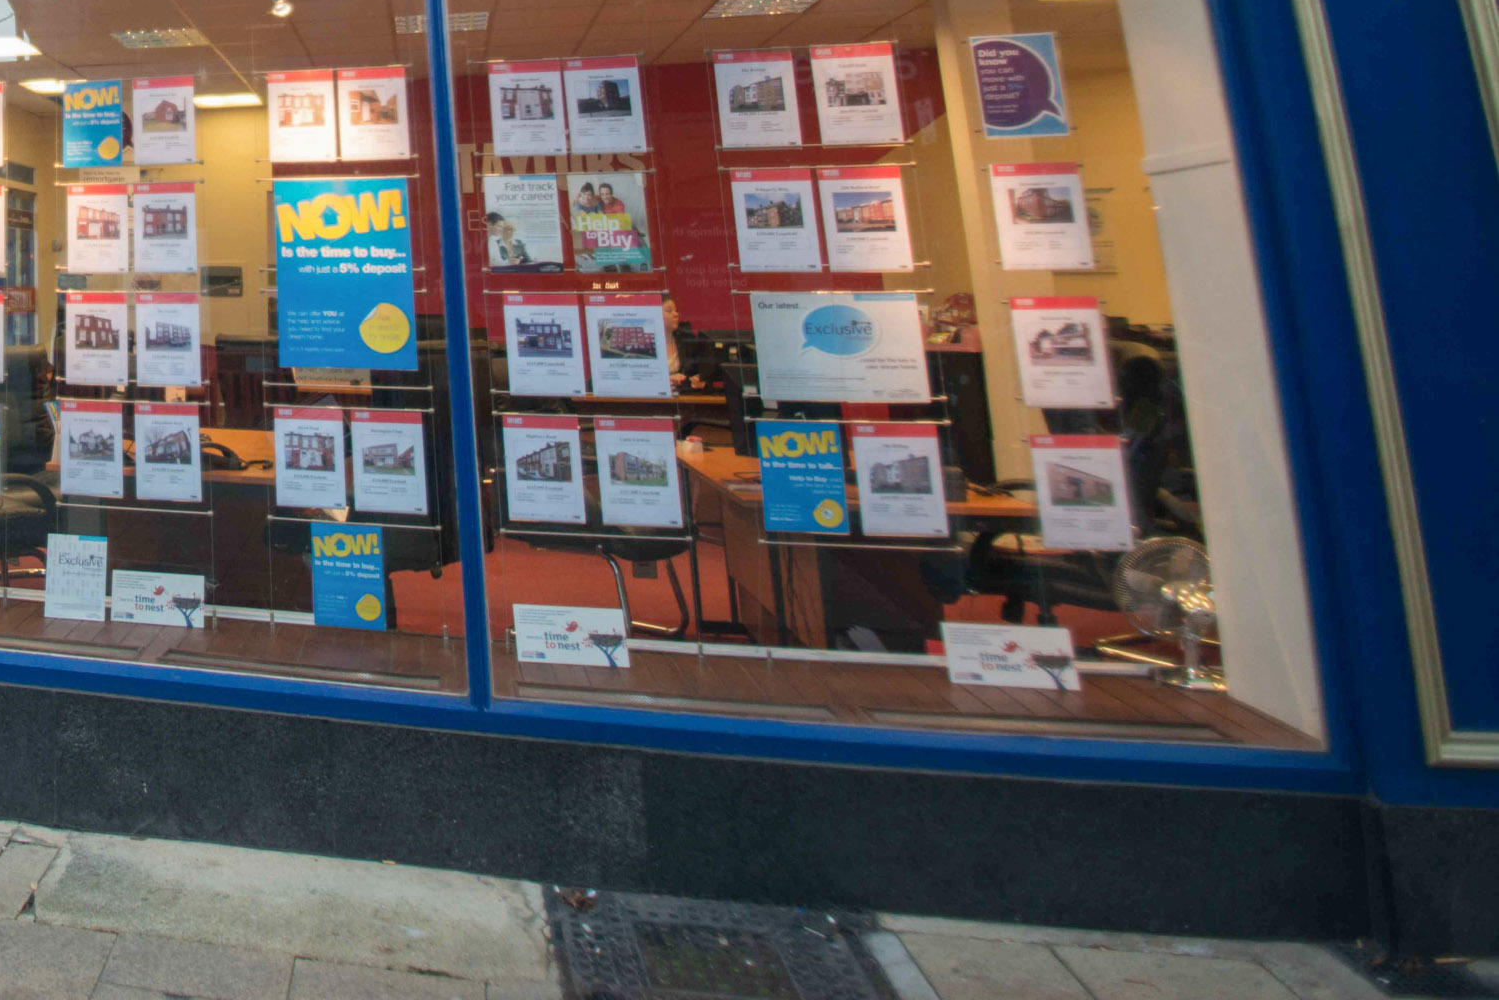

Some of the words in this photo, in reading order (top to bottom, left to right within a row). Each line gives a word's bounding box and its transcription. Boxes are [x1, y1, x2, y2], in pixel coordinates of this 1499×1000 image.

[978, 49, 996, 58] Did
[999, 50, 1019, 58] you
[978, 58, 1007, 66] know
[63, 85, 120, 112] NOW!
[504, 182, 524, 191] Fast
[526, 181, 554, 191] track
[494, 192, 520, 202] your
[521, 191, 555, 201] career
[276, 188, 407, 243] NOW!
[577, 214, 620, 236] Help
[586, 231, 596, 239] to
[597, 231, 633, 252] Buy
[296, 246, 318, 258] the
[320, 245, 351, 258] time
[353, 246, 368, 258] to
[339, 262, 360, 274] 5%
[362, 262, 407, 276] deposit
[805, 321, 873, 336] Exclusive
[758, 430, 839, 459] NOW!
[313, 532, 380, 558] NOW!
[58, 554, 103, 568] Exclusive
[134, 593, 156, 604] time
[134, 603, 144, 611] to
[145, 603, 164, 612] nest
[543, 631, 569, 641] time
[545, 640, 556, 650] to
[557, 641, 581, 651] nest
